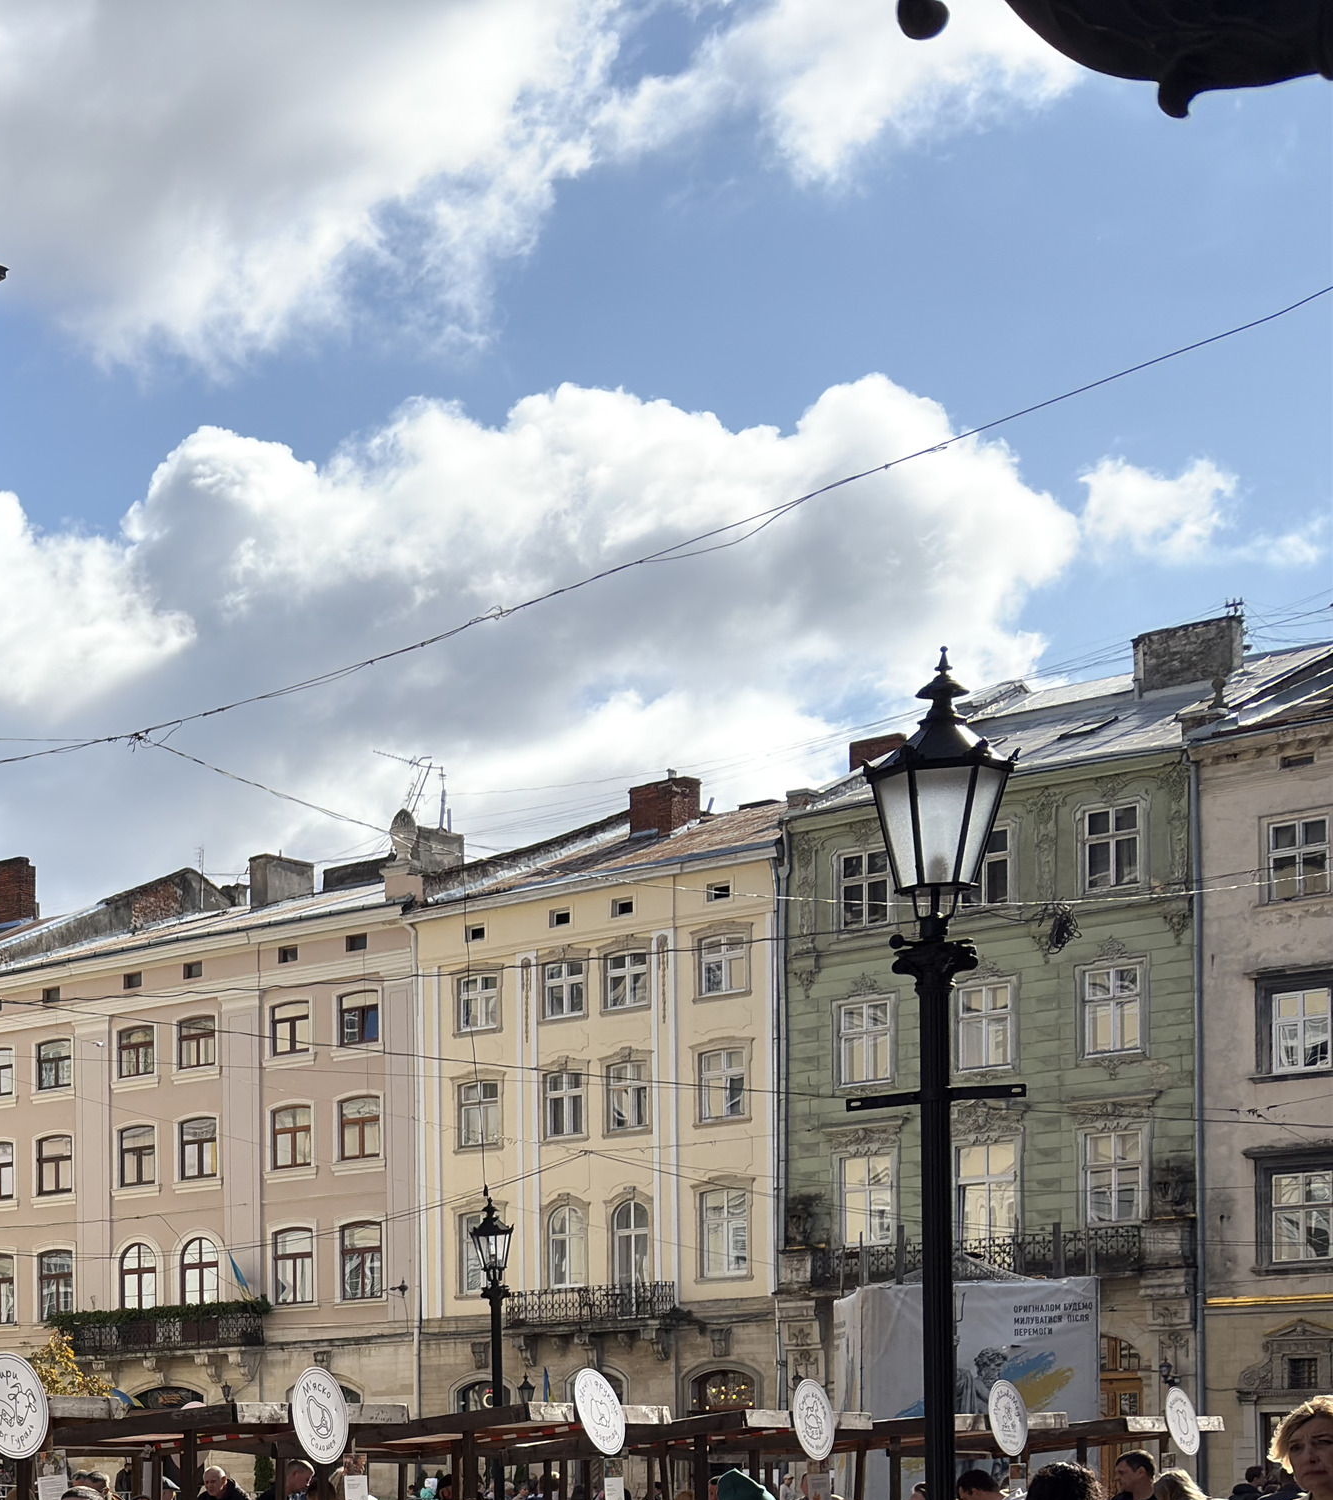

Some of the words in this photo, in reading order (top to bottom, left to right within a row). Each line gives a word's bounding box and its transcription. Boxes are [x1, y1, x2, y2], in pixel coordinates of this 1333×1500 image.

[1013, 1303, 1061, 1314] ОРИГІНАЛОМ
[1063, 1301, 1093, 1312] БУДЕМО
[1013, 1314, 1063, 1325] МИЛУВАТИСЯ
[1067, 1313, 1090, 1323] ПІСЛЯ
[1014, 1327, 1053, 1337] ПЕРЕМОГИ
[302, 1380, 331, 1399] М'яско
